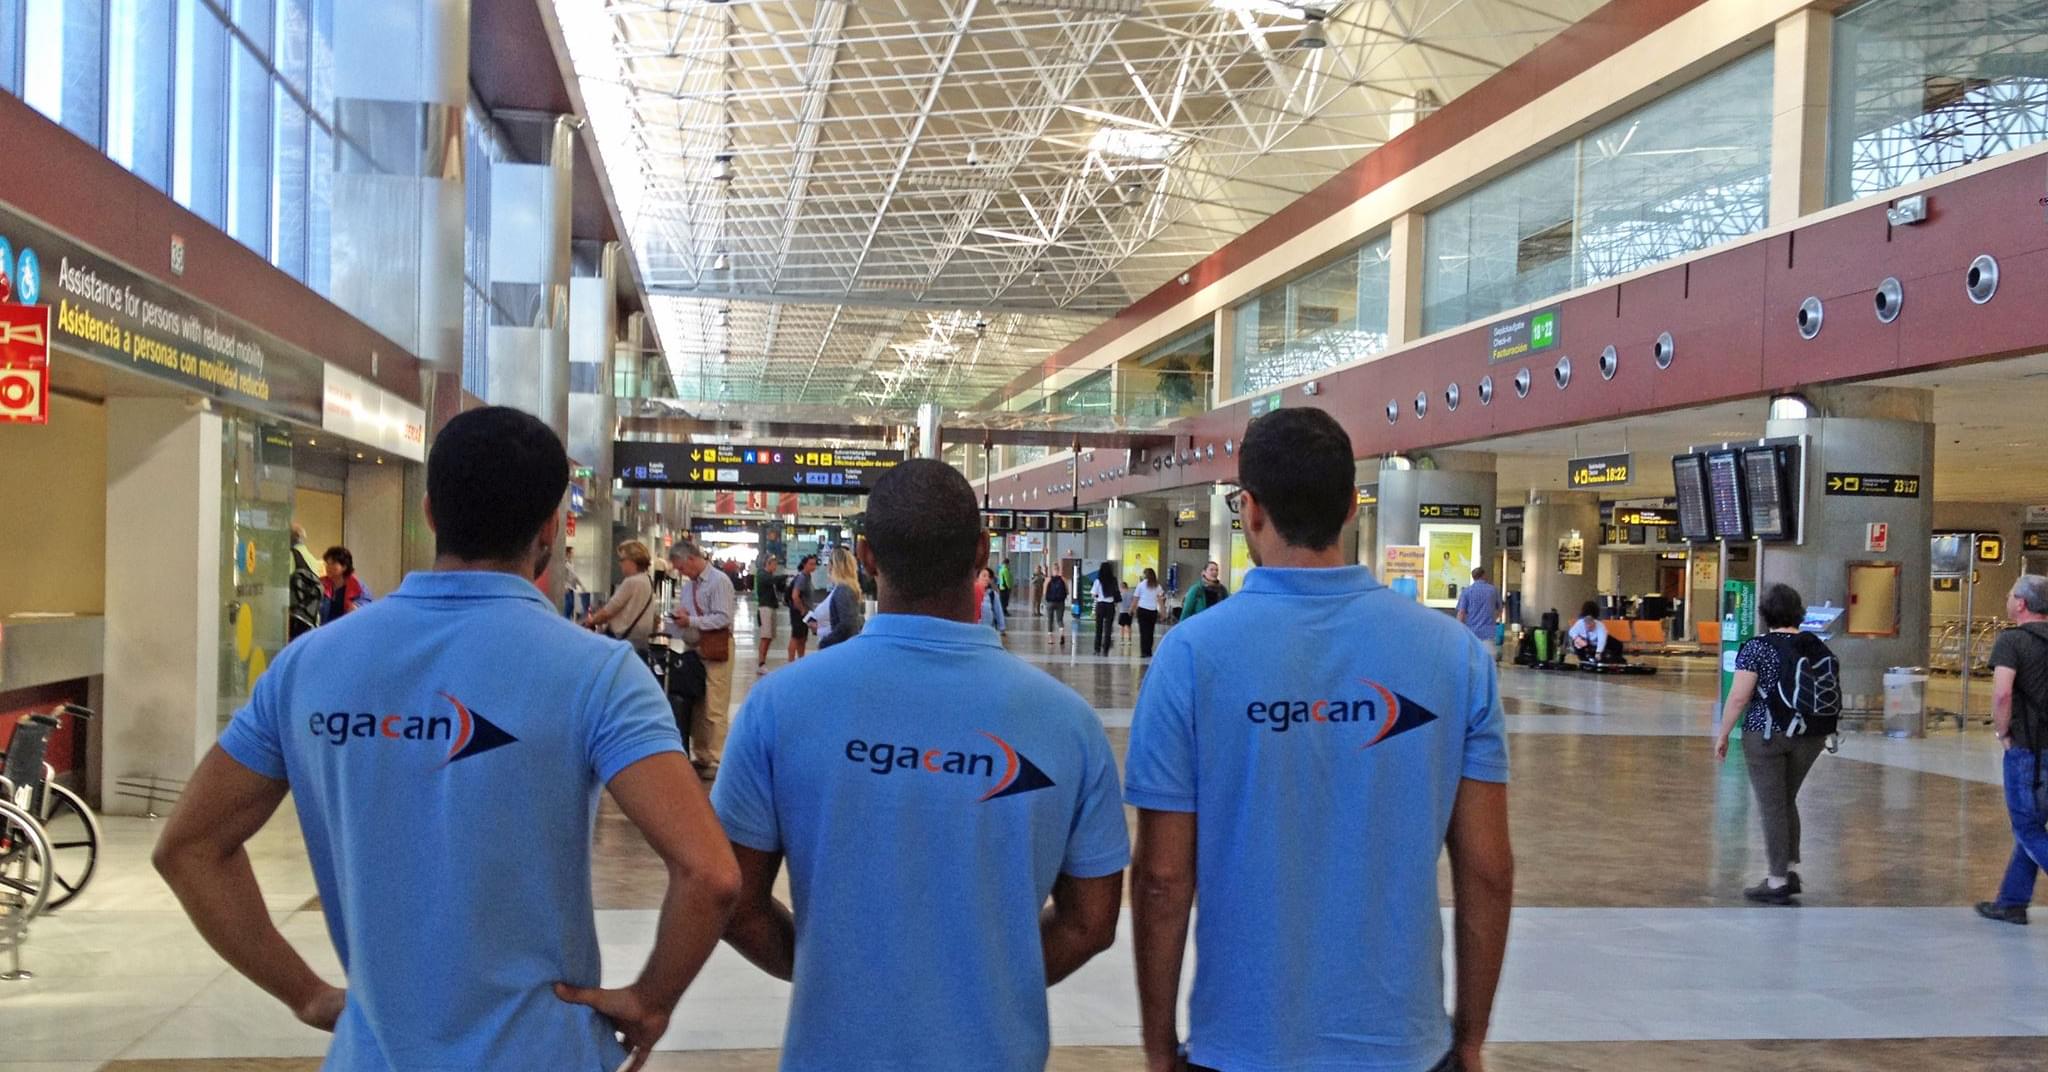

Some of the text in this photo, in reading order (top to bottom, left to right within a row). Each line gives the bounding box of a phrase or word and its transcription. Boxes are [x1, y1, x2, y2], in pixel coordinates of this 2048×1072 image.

[59, 256, 265, 375] Assistance for persons with reduced mobility
[58, 298, 269, 401] Asistencia a personas con movilidad reducida
[309, 711, 452, 747] egacan
[1247, 699, 1376, 733] egacan
[845, 738, 994, 776] egacan
